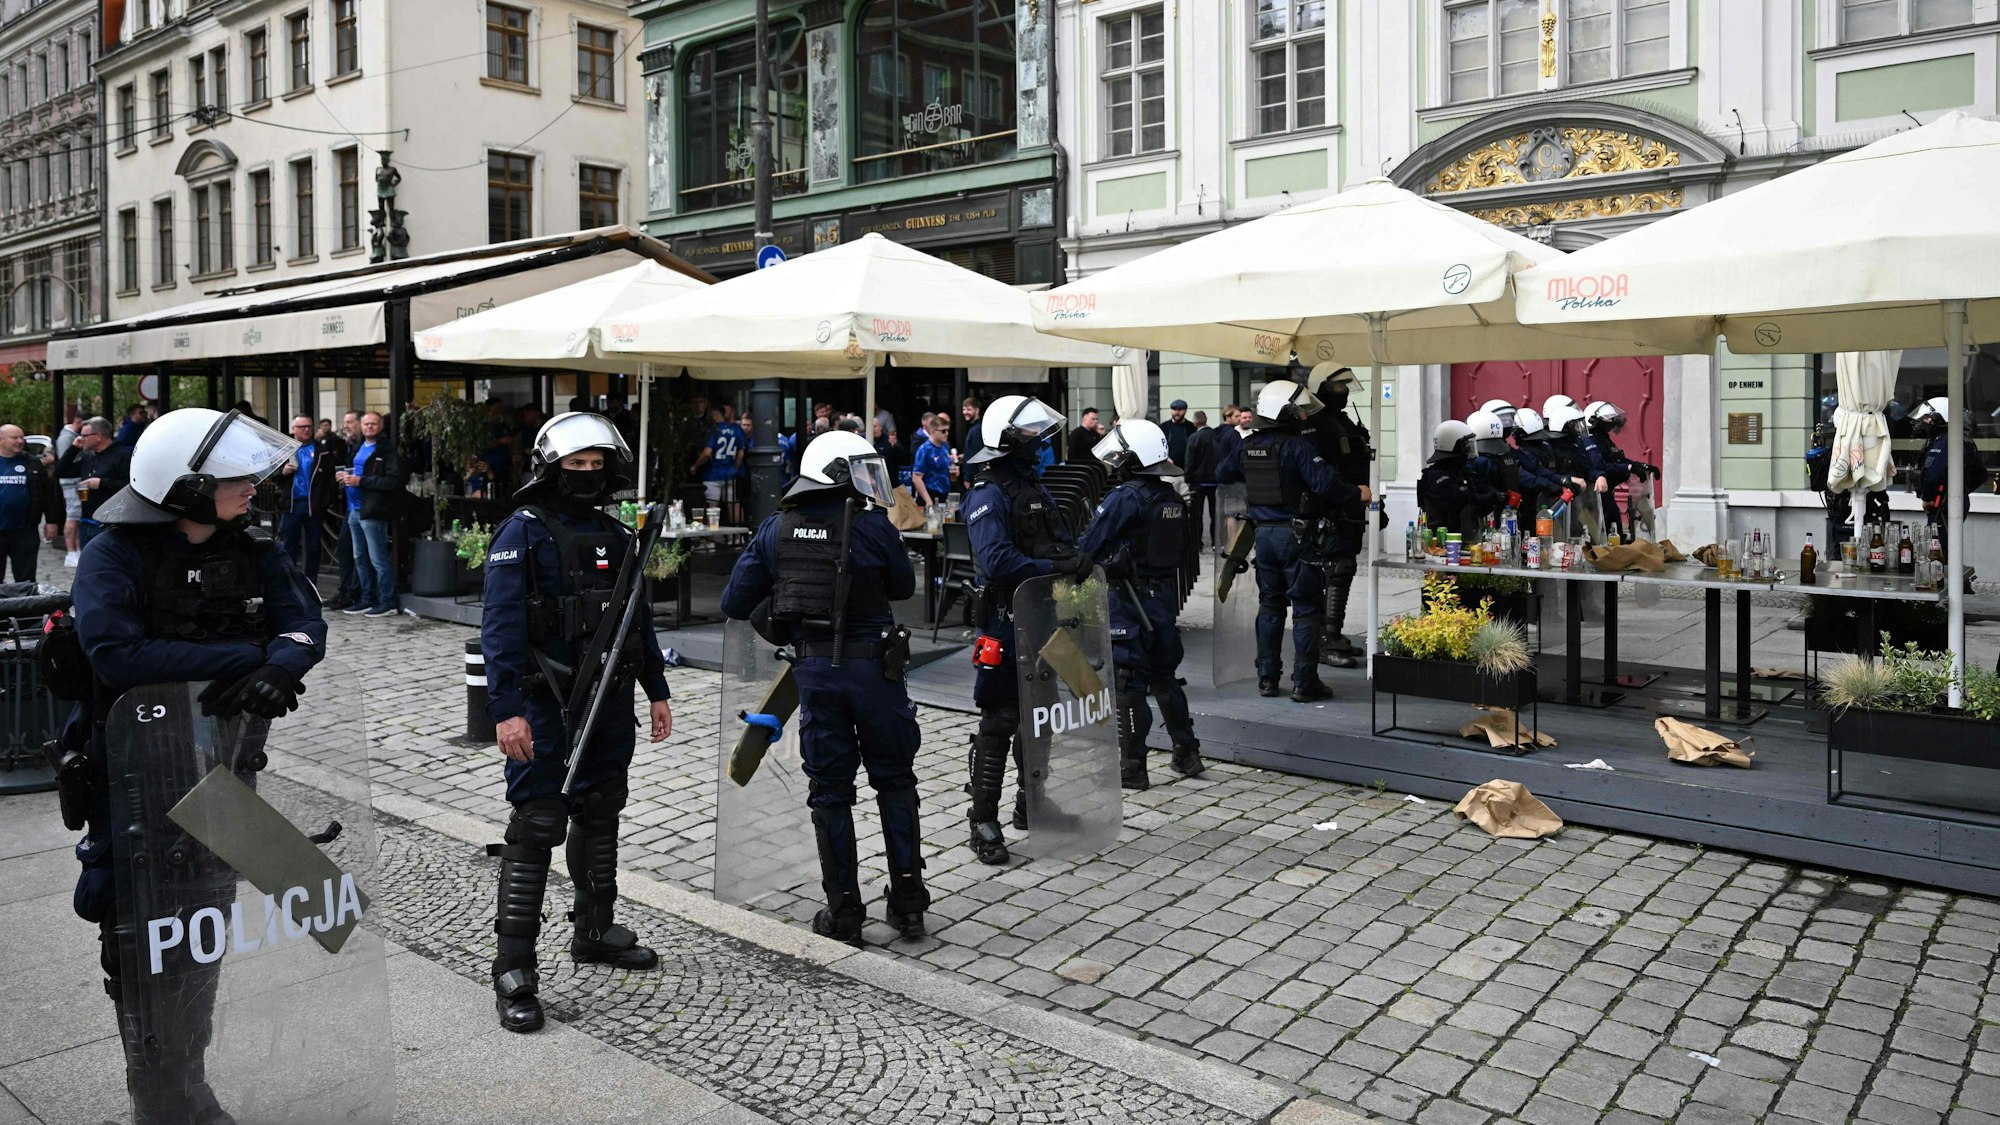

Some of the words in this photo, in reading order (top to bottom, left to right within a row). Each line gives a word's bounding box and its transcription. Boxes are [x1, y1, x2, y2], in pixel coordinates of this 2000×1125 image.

[943, 103, 963, 126] BAR
[905, 214, 946, 230] GUINNESS
[949, 214, 961, 222] THE
[983, 208, 996, 218] PUB
[827, 223, 840, 244] 5
[721, 239, 755, 254] GUINNESS
[1547, 273, 1629, 300] MŁODA
[1046, 293, 1096, 313] MŁODA
[1556, 296, 1621, 311] Polska
[1051, 309, 1090, 321] Polska
[322, 321, 345, 334] GUINNESS
[873, 318, 912, 336] MŁODA
[1728, 381, 1738, 389] OP
[1739, 381, 1764, 389] ENHEIM
[715, 436, 739, 460] 24
[1247, 449, 1268, 457] POLICJA
[970, 504, 989, 521] POLICJA
[1162, 507, 1182, 519] POLICJA
[793, 527, 828, 540] POLICJA
[490, 550, 518, 563] POLICJA
[1033, 687, 1112, 738] POLICJA
[147, 872, 363, 975] POLICJA
